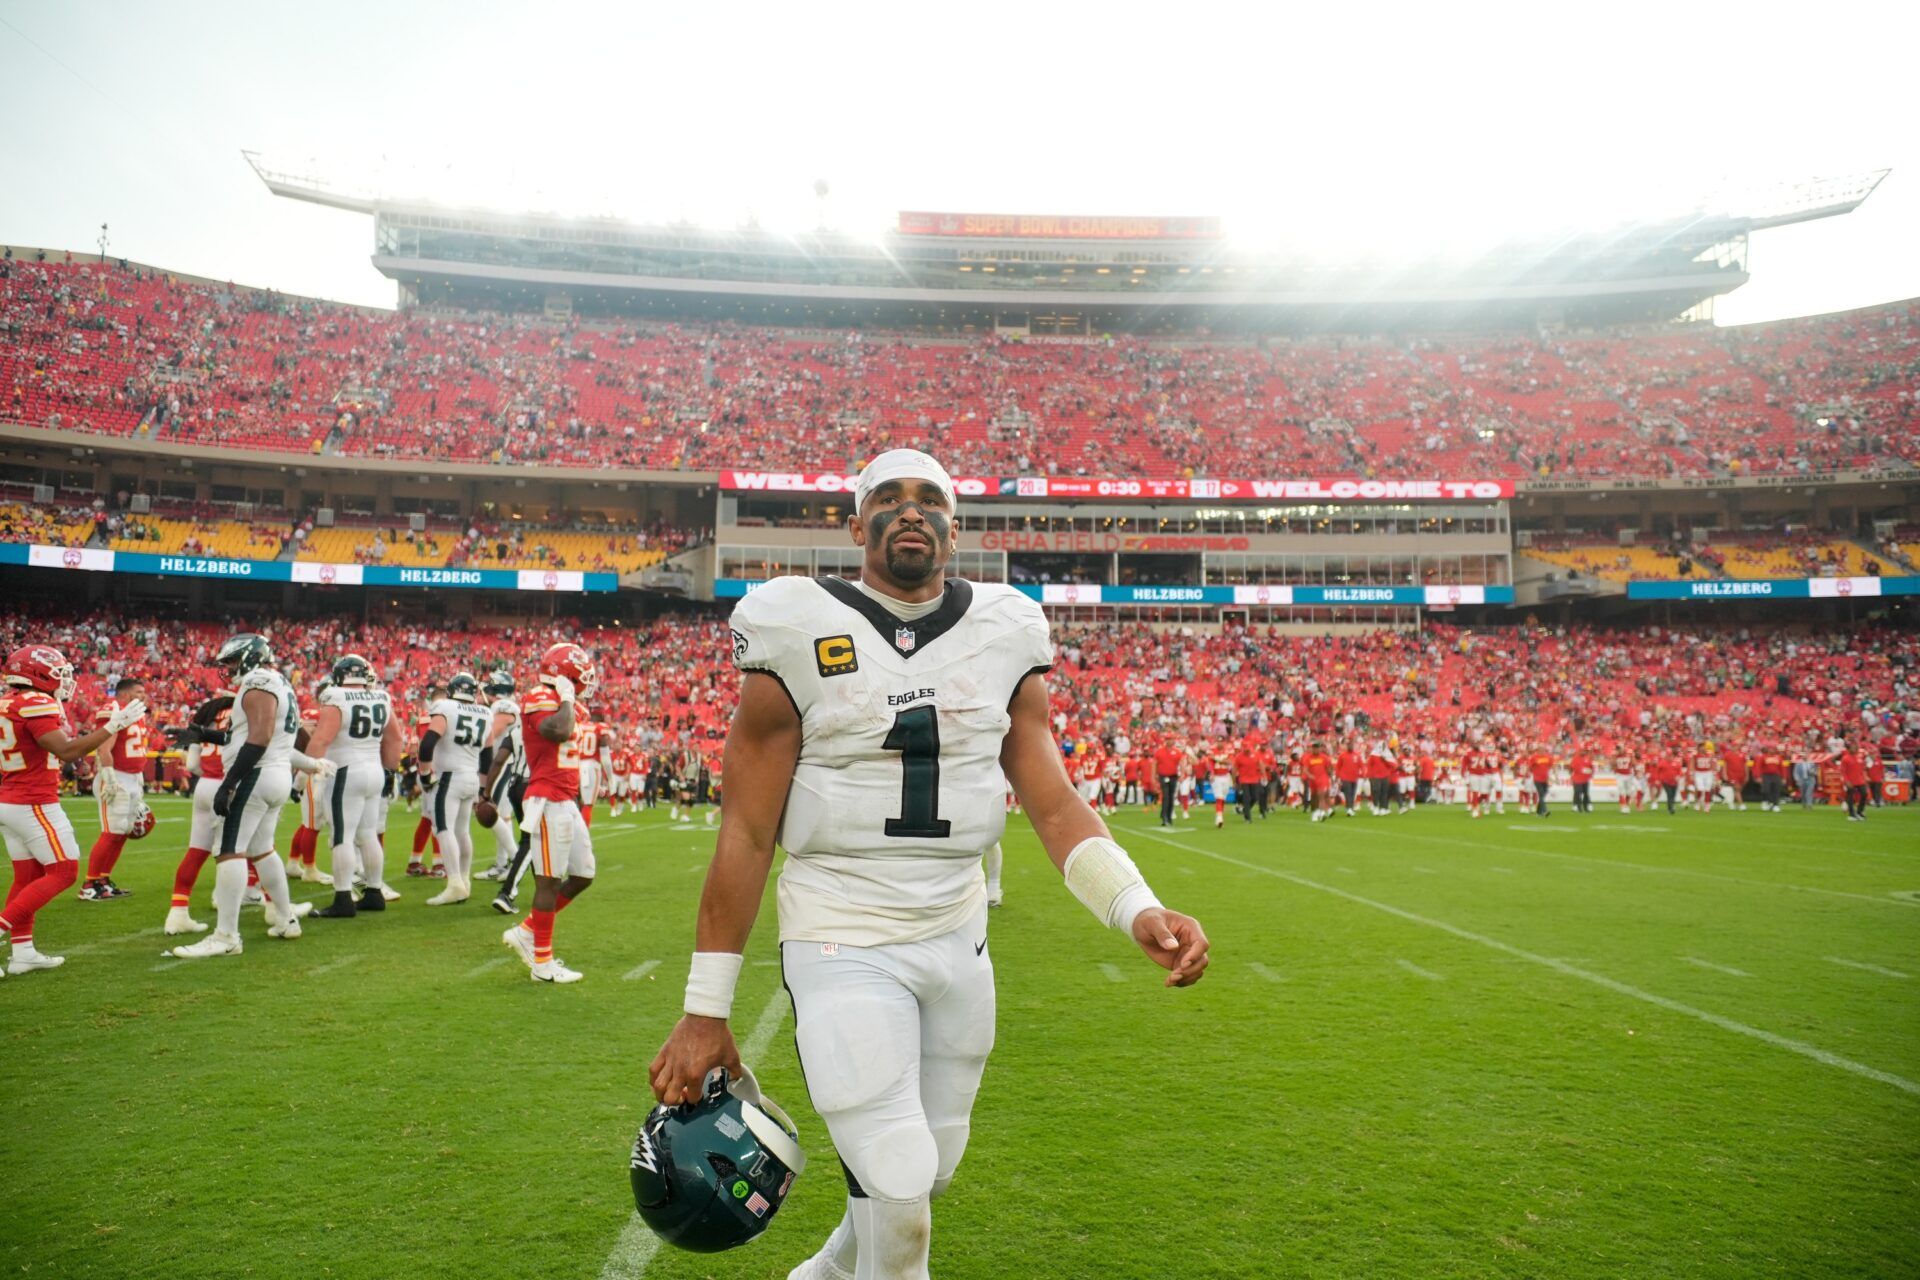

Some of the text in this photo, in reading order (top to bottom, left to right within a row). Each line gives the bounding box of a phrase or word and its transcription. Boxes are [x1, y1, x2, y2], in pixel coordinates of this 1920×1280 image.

[964, 215, 1159, 236] SUPER BOWL CHAMPIONS
[1020, 480, 1034, 494] 20
[1097, 481, 1141, 495] 0:30
[1206, 482, 1216, 496] 17
[1252, 480, 1502, 498] WELCOME TO
[981, 533, 1121, 550] GEHA FIELD
[160, 557, 252, 575] HELZBERG
[400, 569, 482, 584] HELZBERG
[1133, 588, 1203, 600] HELZBERG
[1323, 588, 1394, 600] HELZBERG
[1692, 582, 1772, 595] HELZBERG
[898, 638, 914, 649] NFL
[818, 637, 854, 666] C
[888, 688, 935, 705] EAGLES
[349, 703, 387, 739] 69
[454, 714, 487, 747] 51
[881, 705, 952, 838] 1
[1884, 783, 1900, 796] G
[824, 943, 839, 953] NFL
